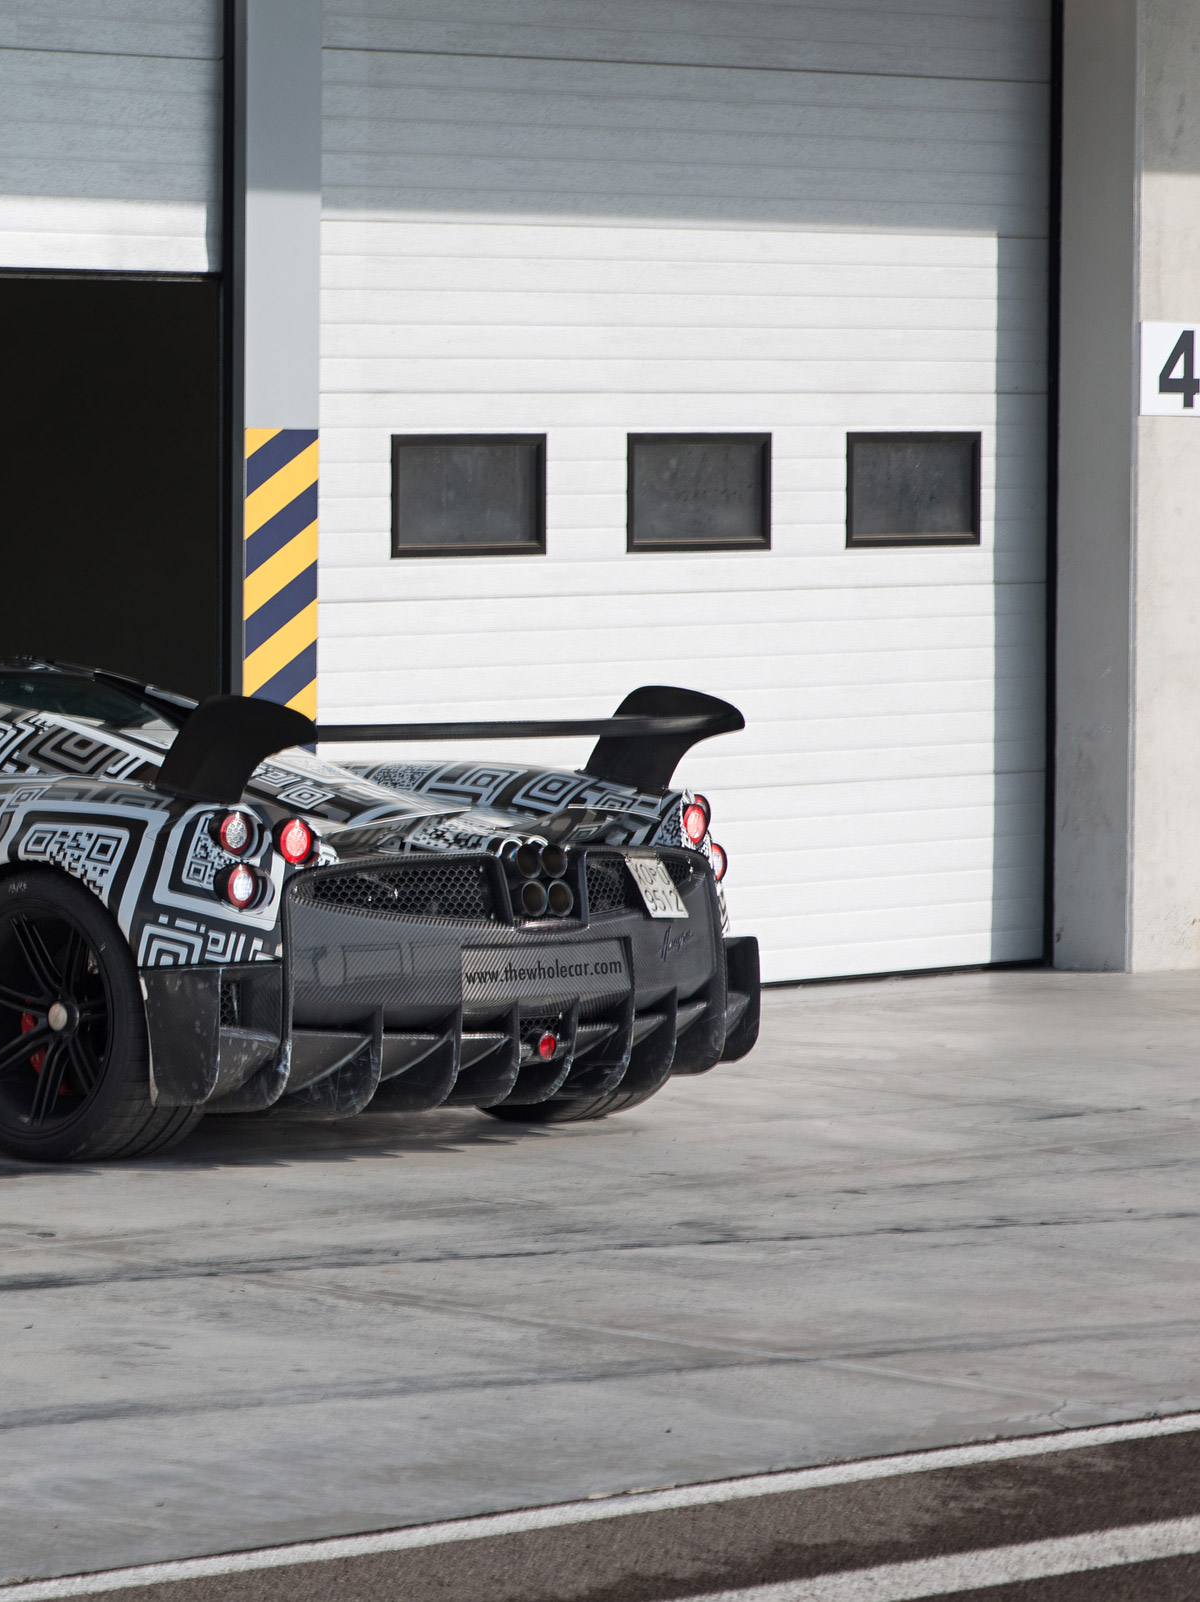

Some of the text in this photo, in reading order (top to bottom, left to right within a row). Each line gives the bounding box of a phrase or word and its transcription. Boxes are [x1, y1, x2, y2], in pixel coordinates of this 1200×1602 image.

[1158, 329, 1200, 408] 4
[644, 889, 684, 912] 9512
[465, 958, 622, 985] www.thewholecar.com
